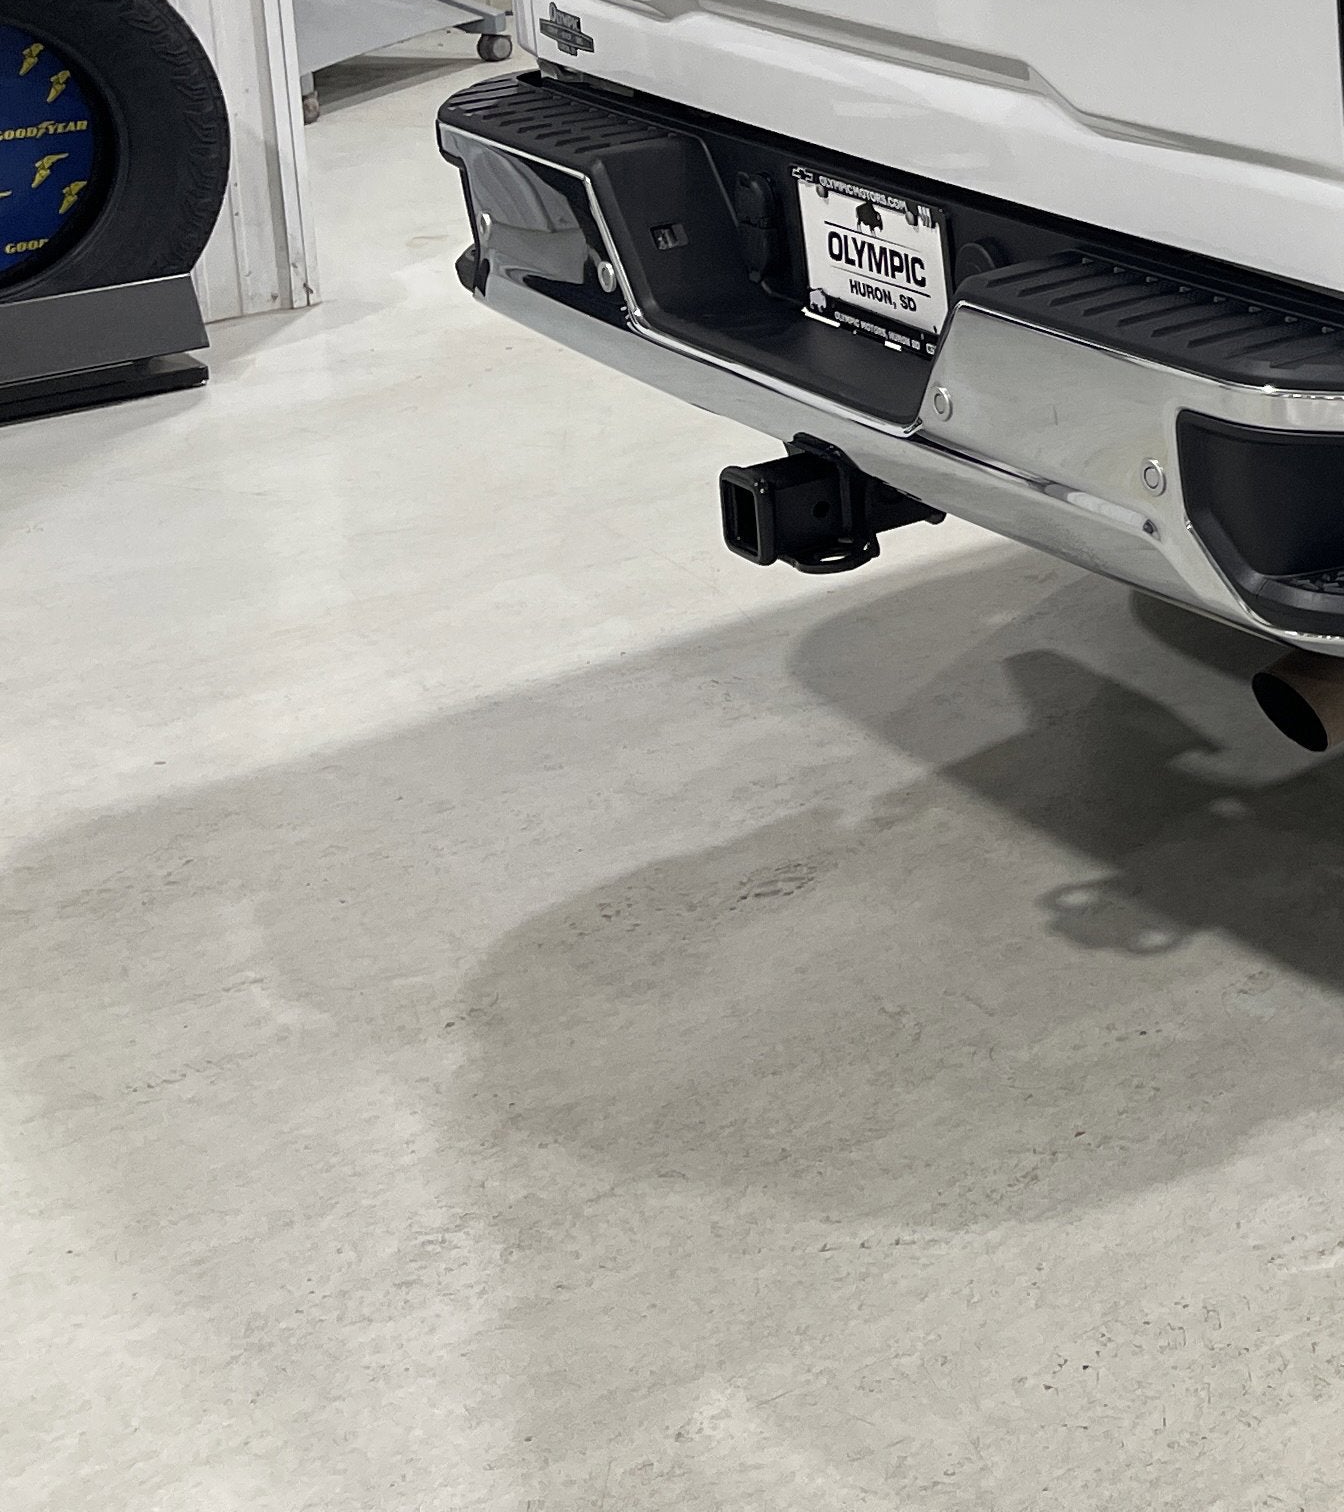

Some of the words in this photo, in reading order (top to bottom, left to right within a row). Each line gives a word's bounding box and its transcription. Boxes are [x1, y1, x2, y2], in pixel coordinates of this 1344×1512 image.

[827, 230, 927, 288] OLYMPIC
[849, 278, 897, 310] HURON,
[900, 294, 917, 312] SD
